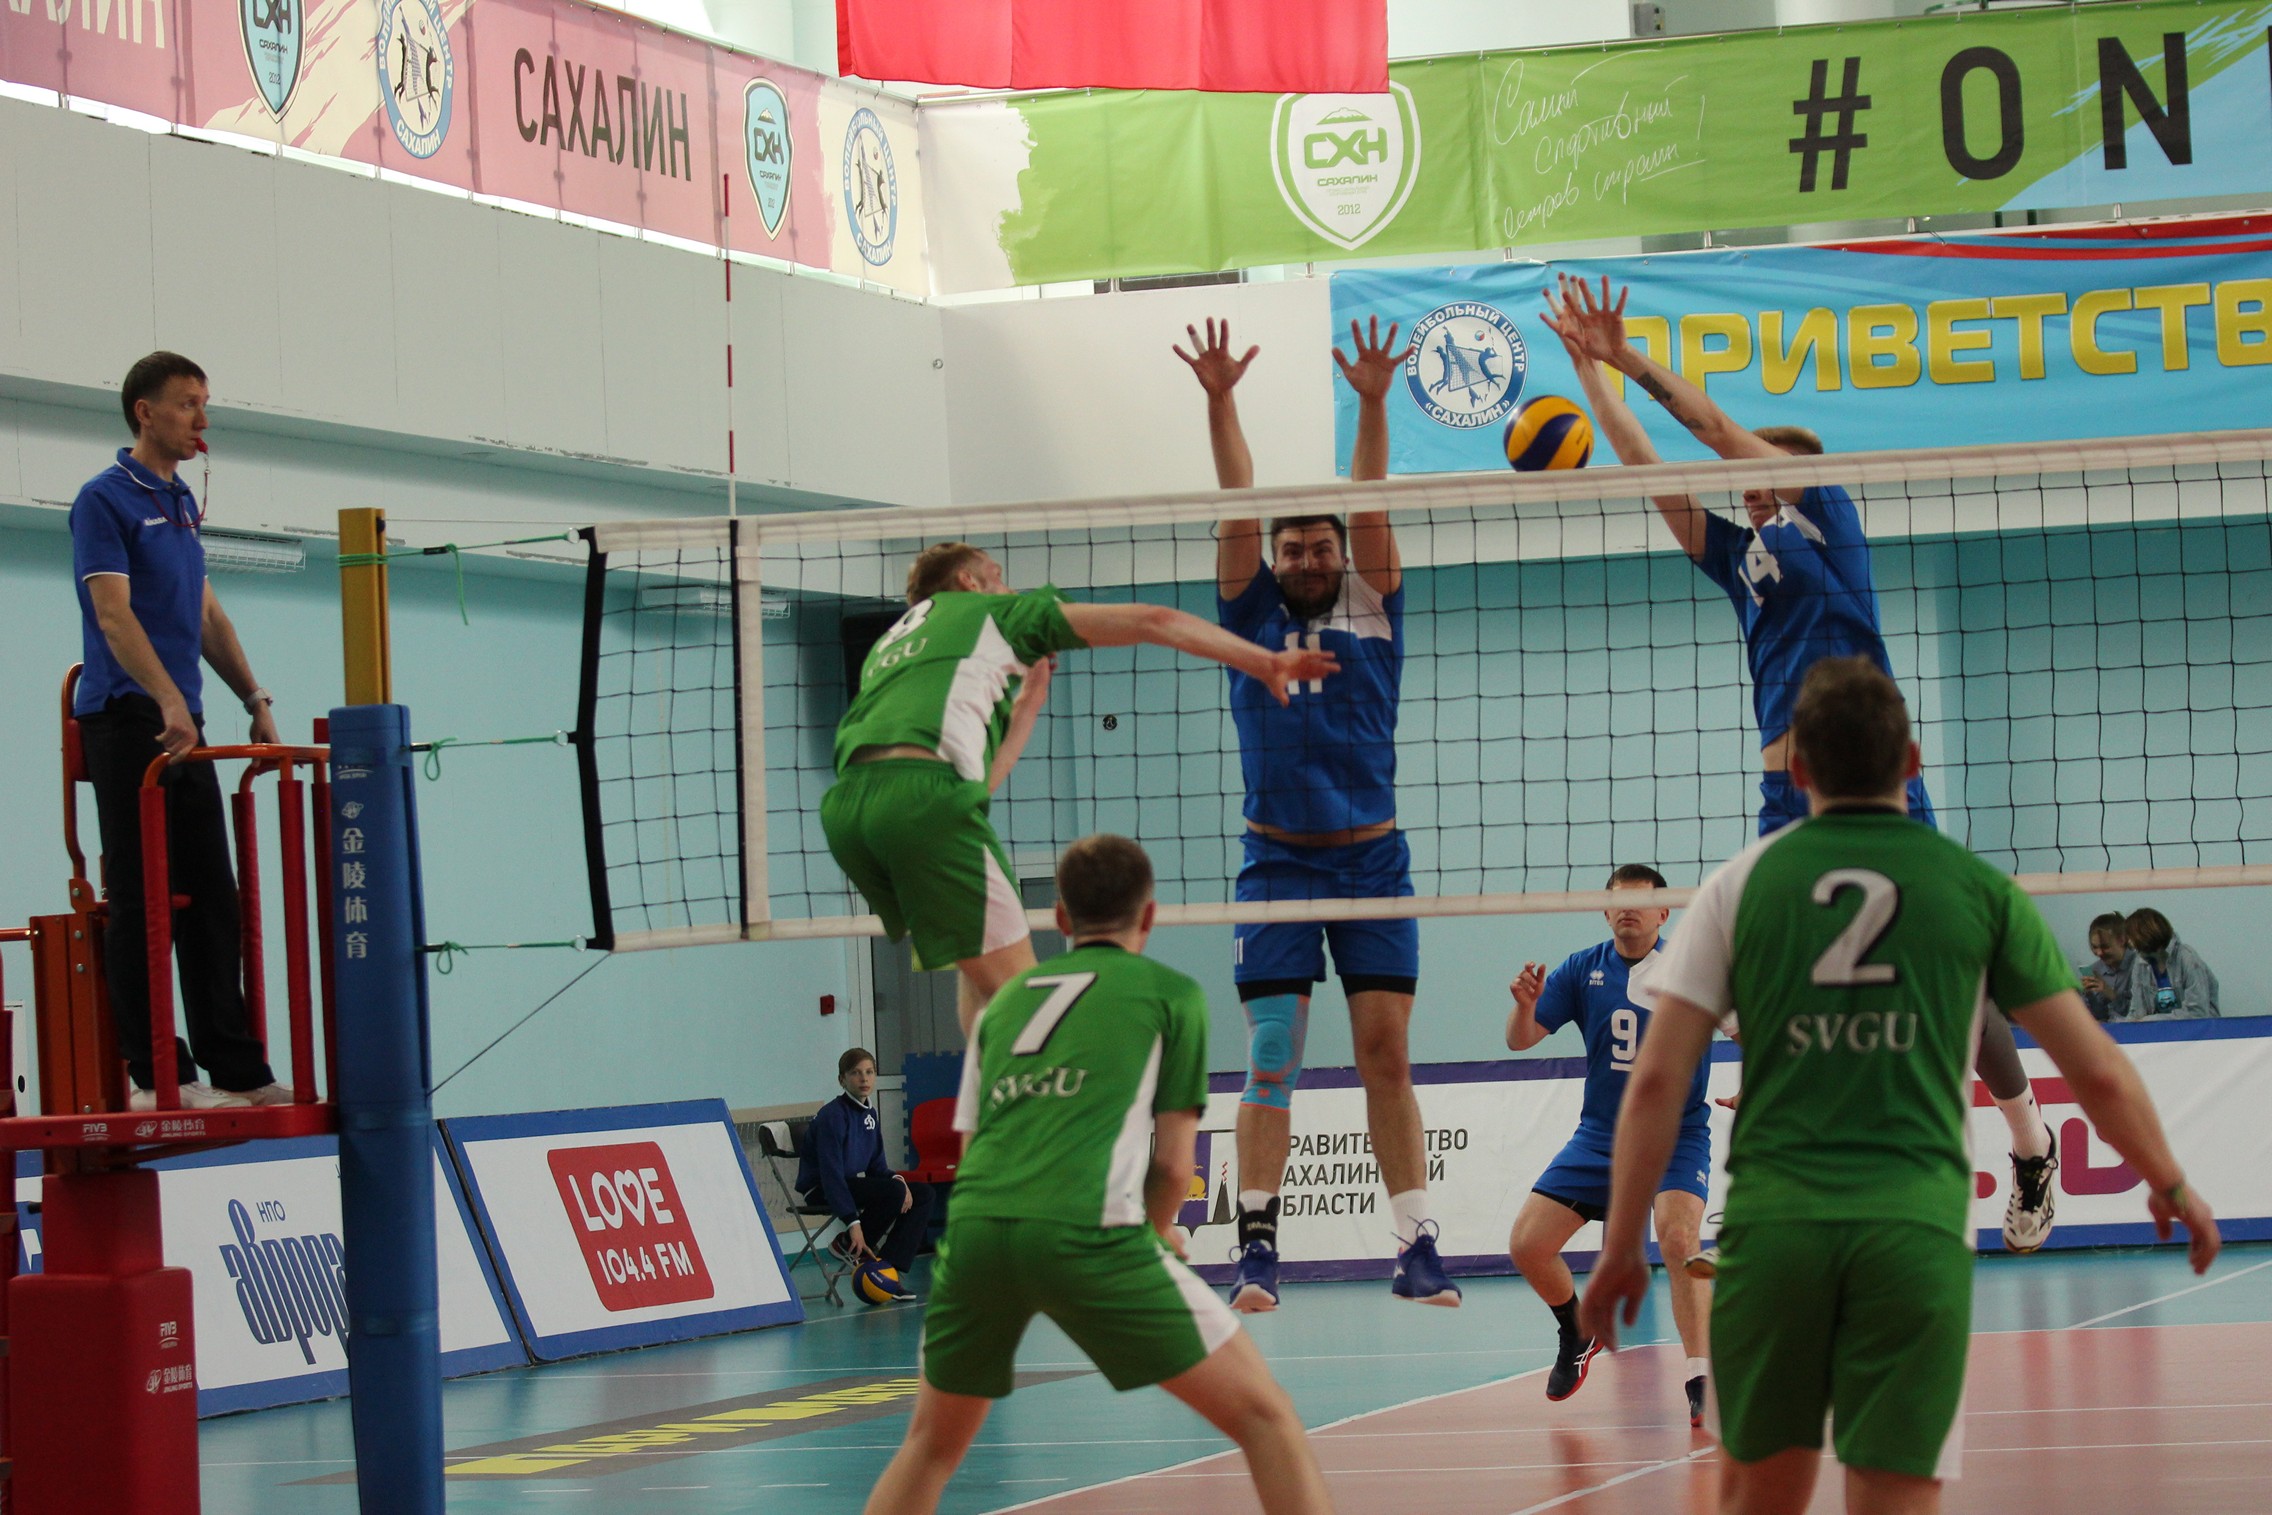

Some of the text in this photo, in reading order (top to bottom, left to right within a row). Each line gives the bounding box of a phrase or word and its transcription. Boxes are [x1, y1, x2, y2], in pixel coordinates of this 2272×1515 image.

[514, 47, 692, 182] САХАЛИН
[1789, 26, 2272, 192] #ON
[396, 119, 441, 156] САХАЛИН
[1317, 174, 1378, 187] САХАЛИН
[1337, 203, 1361, 216] 2012
[857, 234, 892, 263] САХАЛИН
[1500, 321, 1525, 373] ЦЕНТР
[866, 637, 929, 678] GU
[342, 826, 370, 960] 金陵体育
[1811, 867, 1900, 986] 2
[1010, 971, 1098, 1056] 7
[1786, 1011, 1918, 1057] SVGU
[1611, 1008, 1638, 1061] 9
[83, 1122, 107, 1133] FIVB
[1287, 1128, 1469, 1157] РАВИТЕТВО
[1282, 1154, 1445, 1187] АХАЛИНЙ
[256, 1200, 286, 1223] НПО
[568, 1167, 675, 1232] LOVE
[1276, 1191, 1376, 1217] БЛАСТИ
[597, 1240, 695, 1285] 104.4 FM
[160, 1320, 177, 1337] FIVB
